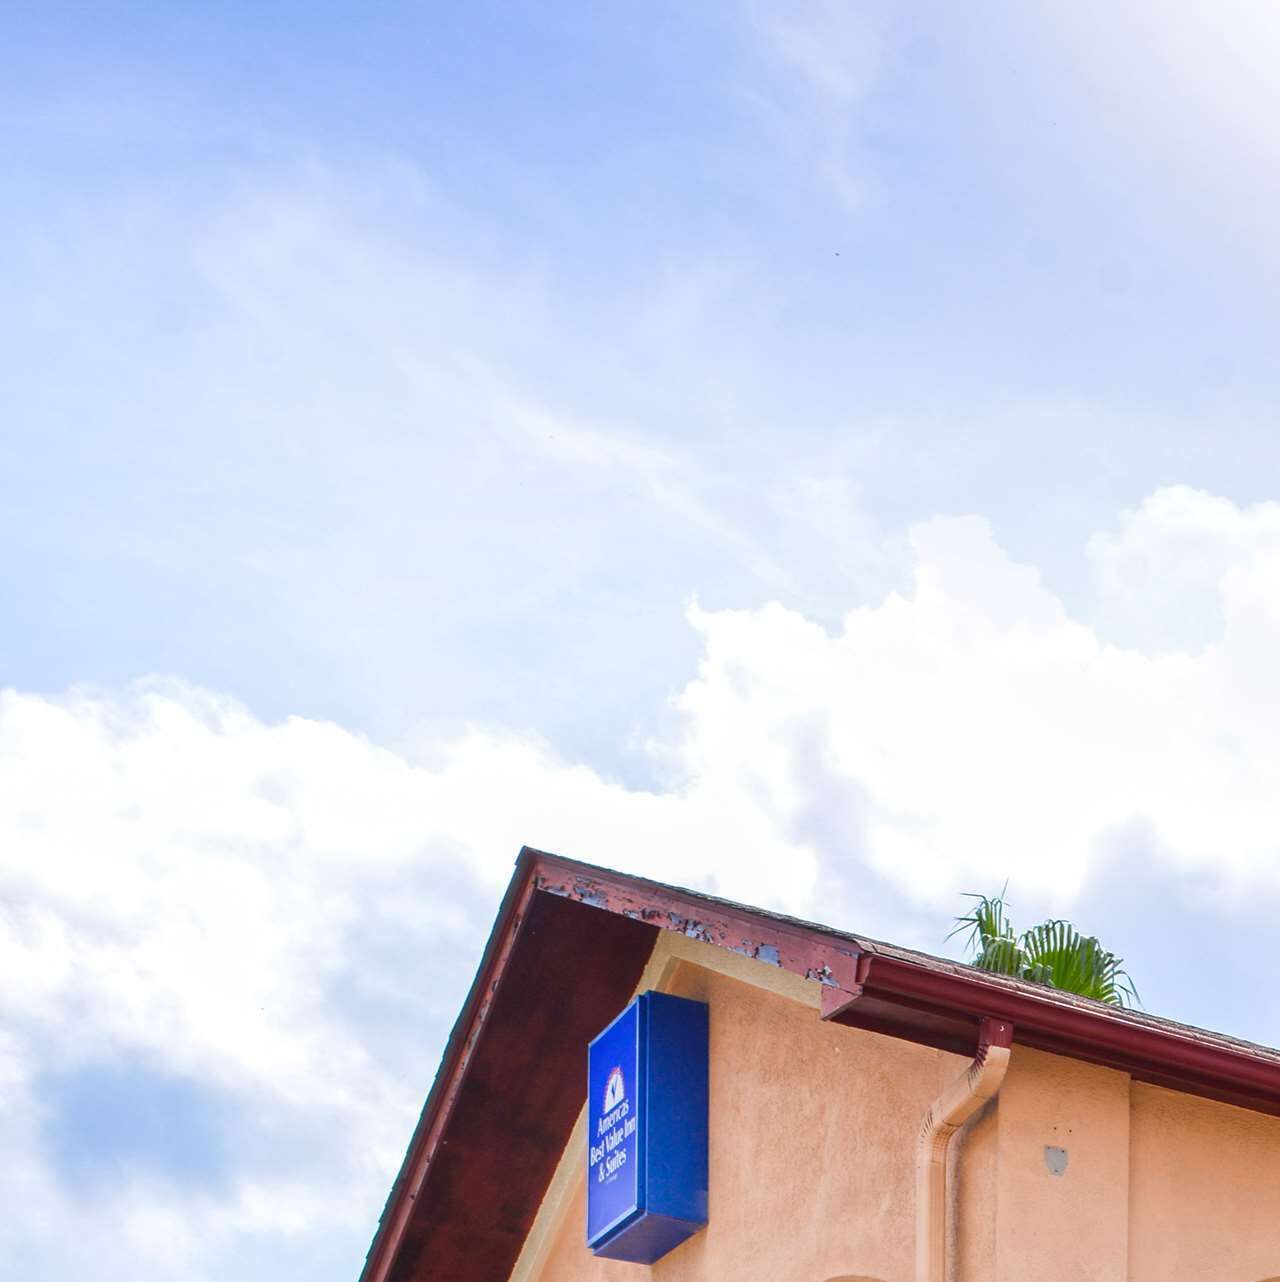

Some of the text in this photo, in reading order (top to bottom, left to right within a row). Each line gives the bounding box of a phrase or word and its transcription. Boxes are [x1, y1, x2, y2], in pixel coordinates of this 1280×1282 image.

[591, 1116, 636, 1168] Best Value Inn
[606, 1148, 626, 1177] Suites
